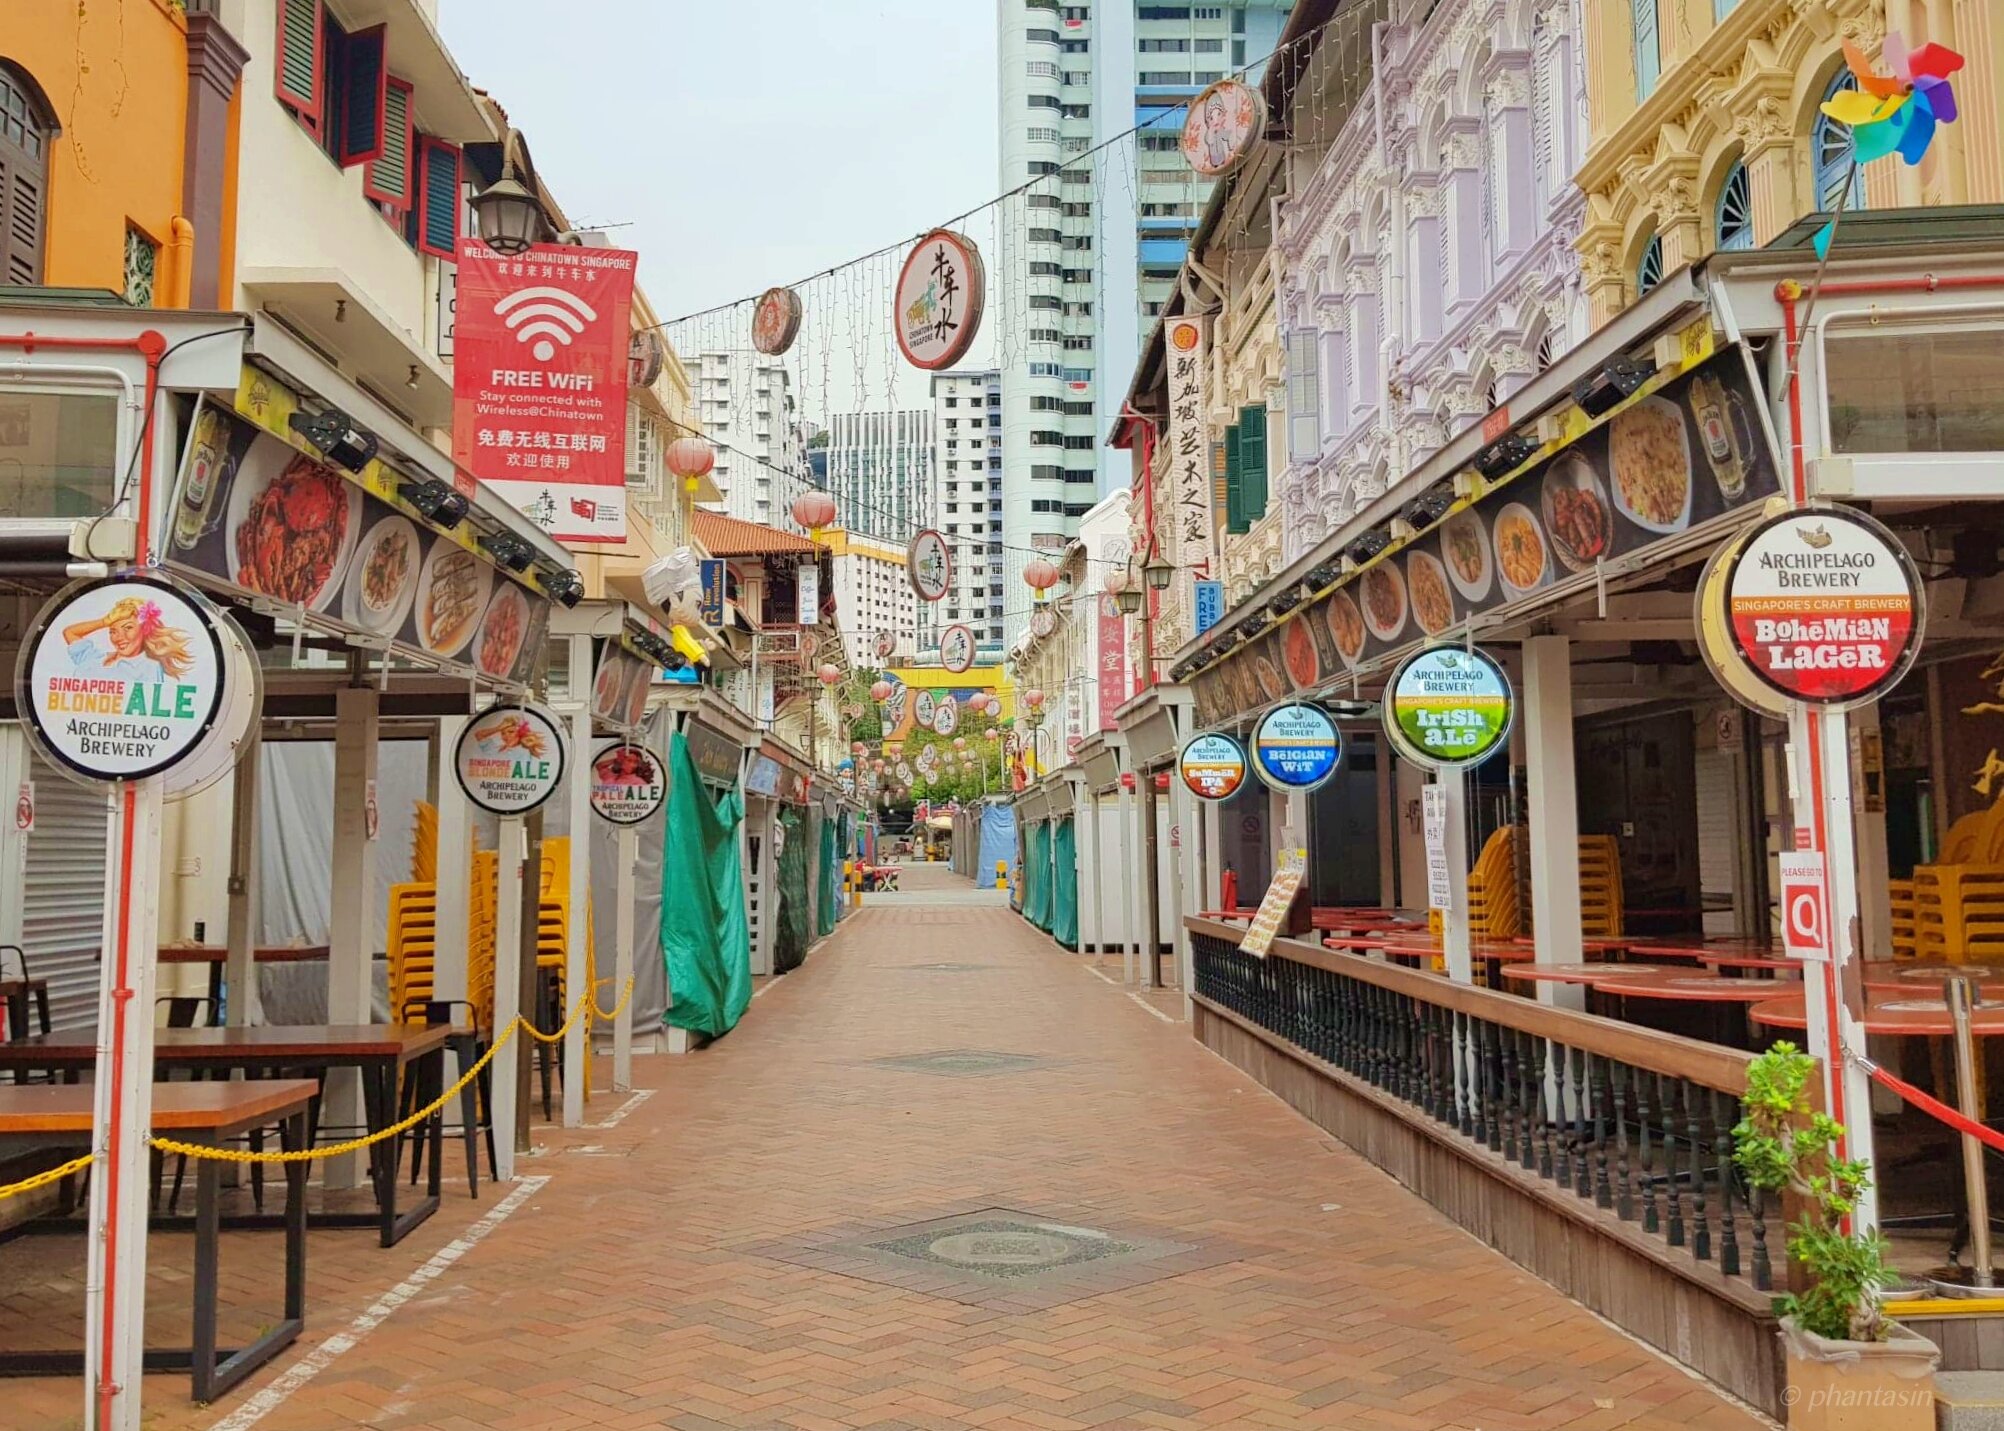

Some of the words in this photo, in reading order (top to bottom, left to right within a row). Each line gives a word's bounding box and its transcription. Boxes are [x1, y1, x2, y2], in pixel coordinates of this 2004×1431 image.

[526, 253, 579, 266] CHINATOWN
[580, 257, 631, 270] SINGAPORE
[498, 262, 597, 283] 欢迎来到牛车水
[491, 369, 543, 388] FREE
[547, 371, 593, 391] WiFi
[479, 389, 507, 405] Stay
[509, 393, 573, 406] connected
[576, 396, 603, 408] with
[476, 403, 604, 421] Wireless@Chinatown
[477, 428, 606, 454] 免费无线互联网
[506, 453, 571, 470] 欢迎使用
[1759, 551, 1875, 569] ARCHIPELAGO
[1778, 571, 1861, 588] BREWERY
[1734, 600, 1811, 611] SINGAPORE'S
[1814, 599, 1850, 610] CRAFT
[1855, 599, 1911, 610] BREWERY
[1412, 669, 1484, 681] ARCHIPELAGO
[49, 677, 125, 695] SINGAPORE
[1423, 681, 1475, 692] BREWERY
[47, 691, 123, 716] BLONDE
[124, 682, 198, 719] ALE
[66, 717, 171, 741] ARCHIPELAGO
[1273, 720, 1321, 729] ARCHIPELAGO
[1279, 728, 1315, 737] BREWERY
[80, 738, 156, 758] BREWERY
[467, 758, 512, 767] SINGAPORE
[467, 766, 510, 778] BLONDE
[511, 760, 551, 780] ALE
[480, 780, 537, 791] ARCHIPELAGO
[1200, 777, 1226, 787] IPA
[487, 790, 529, 801] BREWERY
[592, 791, 624, 801] PALE
[625, 785, 660, 801] ALE
[602, 801, 649, 810] ARCHIPELAGO
[608, 809, 643, 818] BREWERY
[1781, 867, 1806, 877] PLEASE
[1806, 867, 1815, 877] GO
[1815, 867, 1823, 877] TO
[1791, 893, 1821, 945] Q
